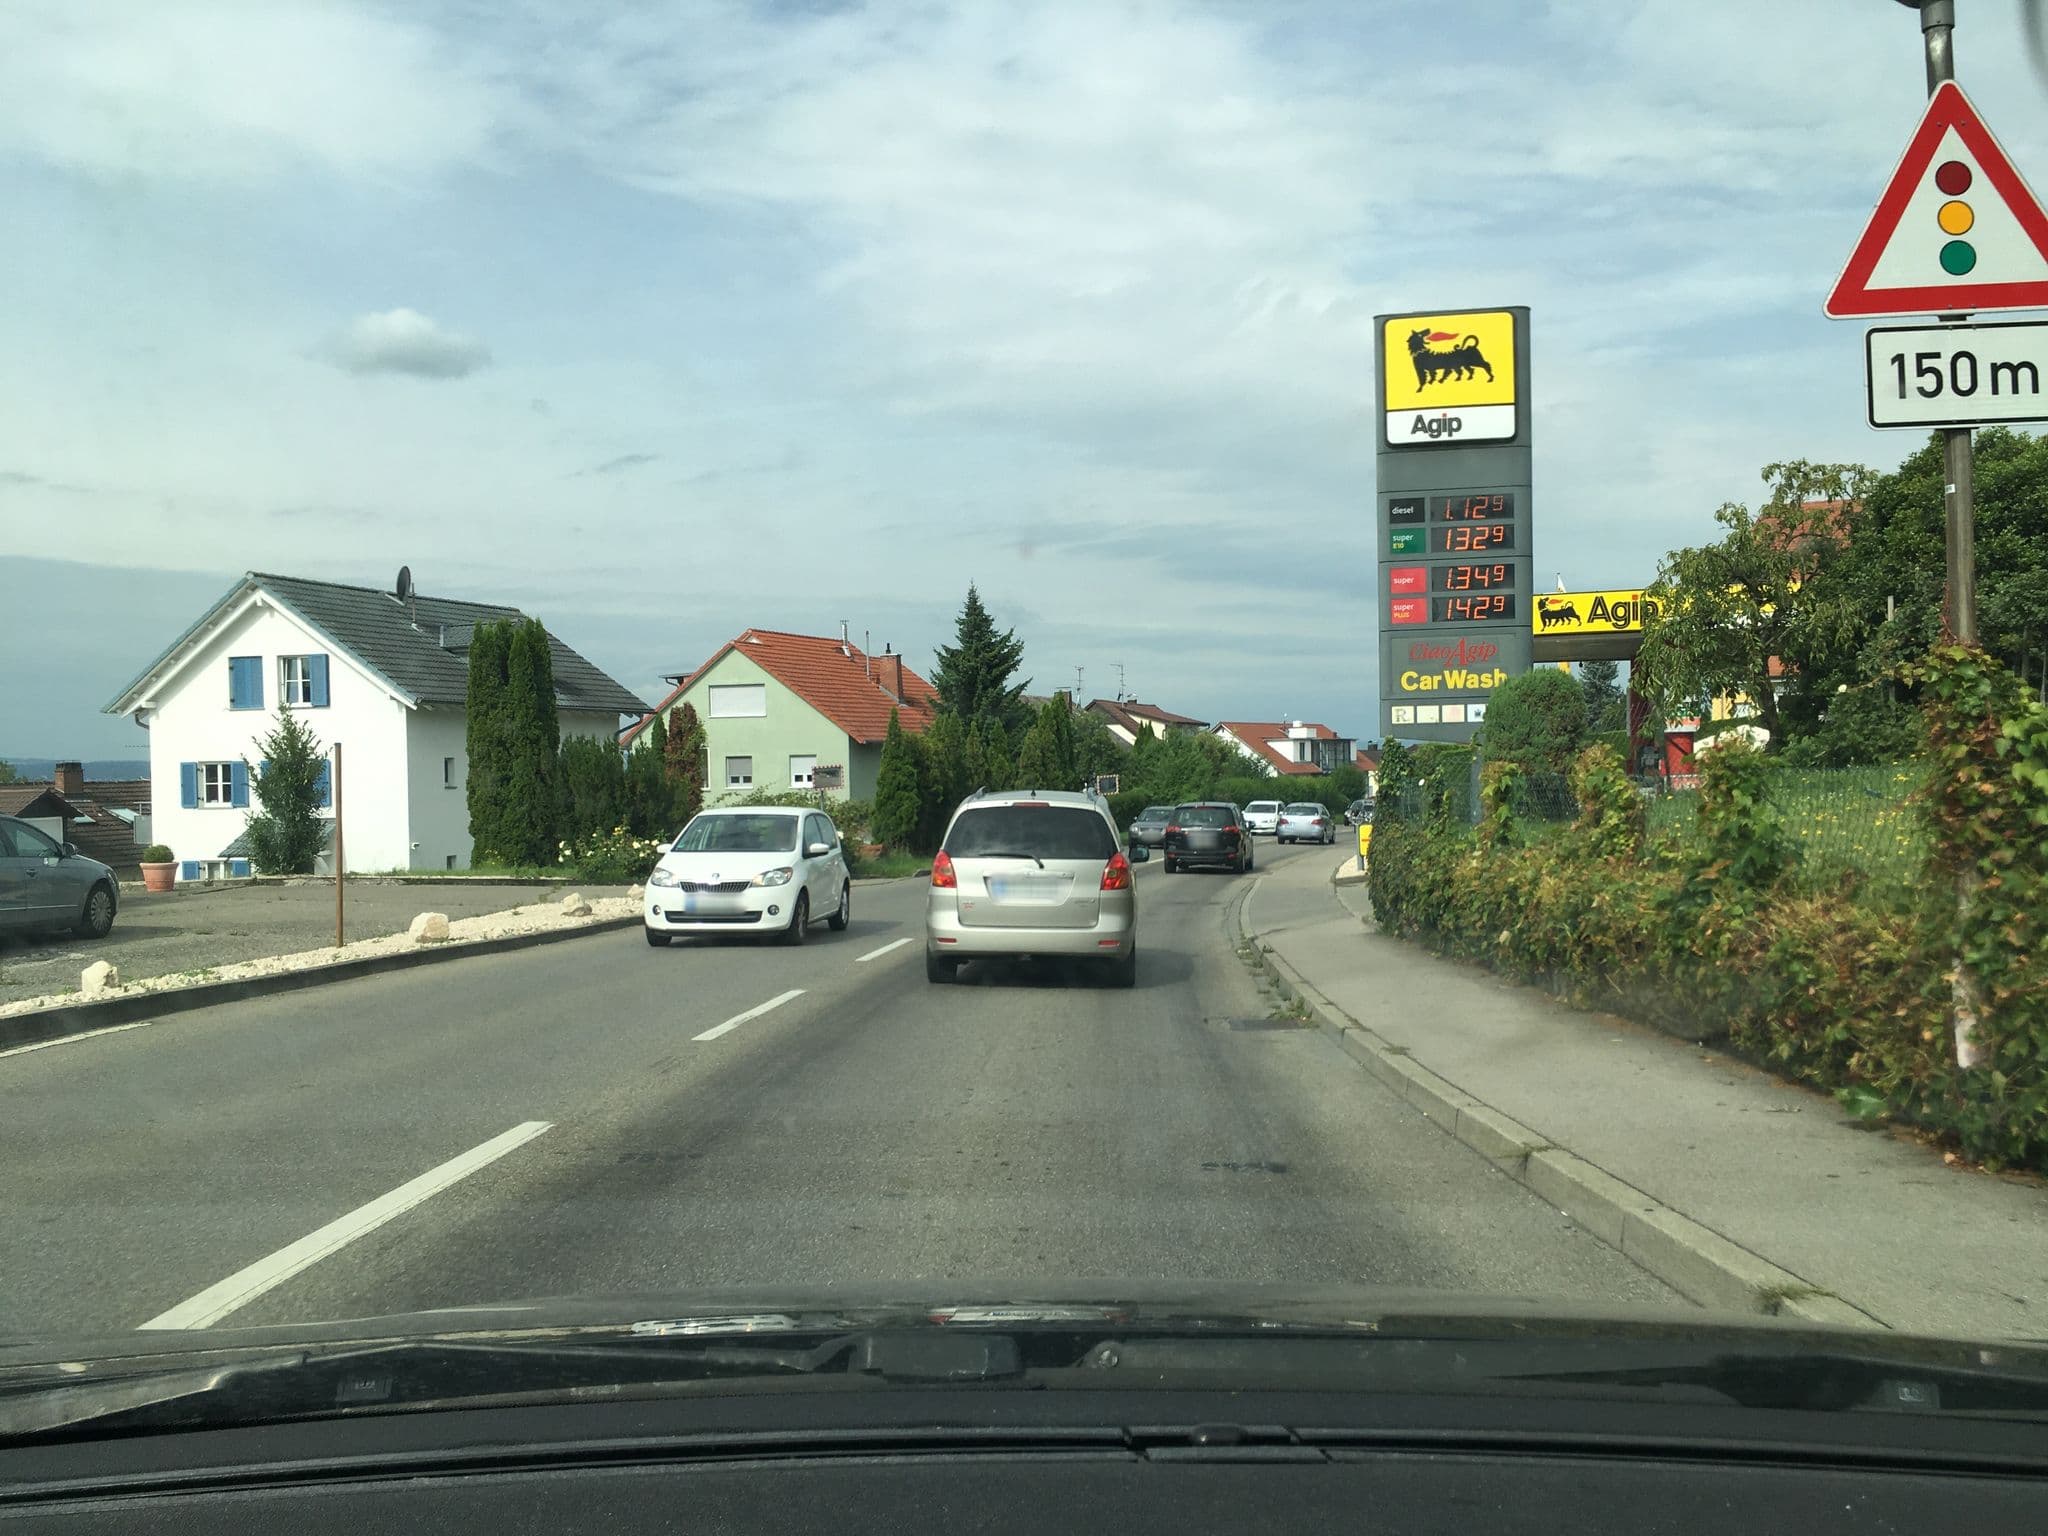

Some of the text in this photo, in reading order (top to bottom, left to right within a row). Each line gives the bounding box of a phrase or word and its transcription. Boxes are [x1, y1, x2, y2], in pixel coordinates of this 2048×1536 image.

[1890, 351, 2040, 399] 150 m
[1411, 413, 1462, 439] Agip
[1392, 506, 1414, 515] diesel
[1392, 534, 1414, 543] super
[1393, 577, 1415, 586] super
[1393, 603, 1415, 613] super
[1587, 594, 1660, 630] Agip
[1400, 670, 1442, 691] Car
